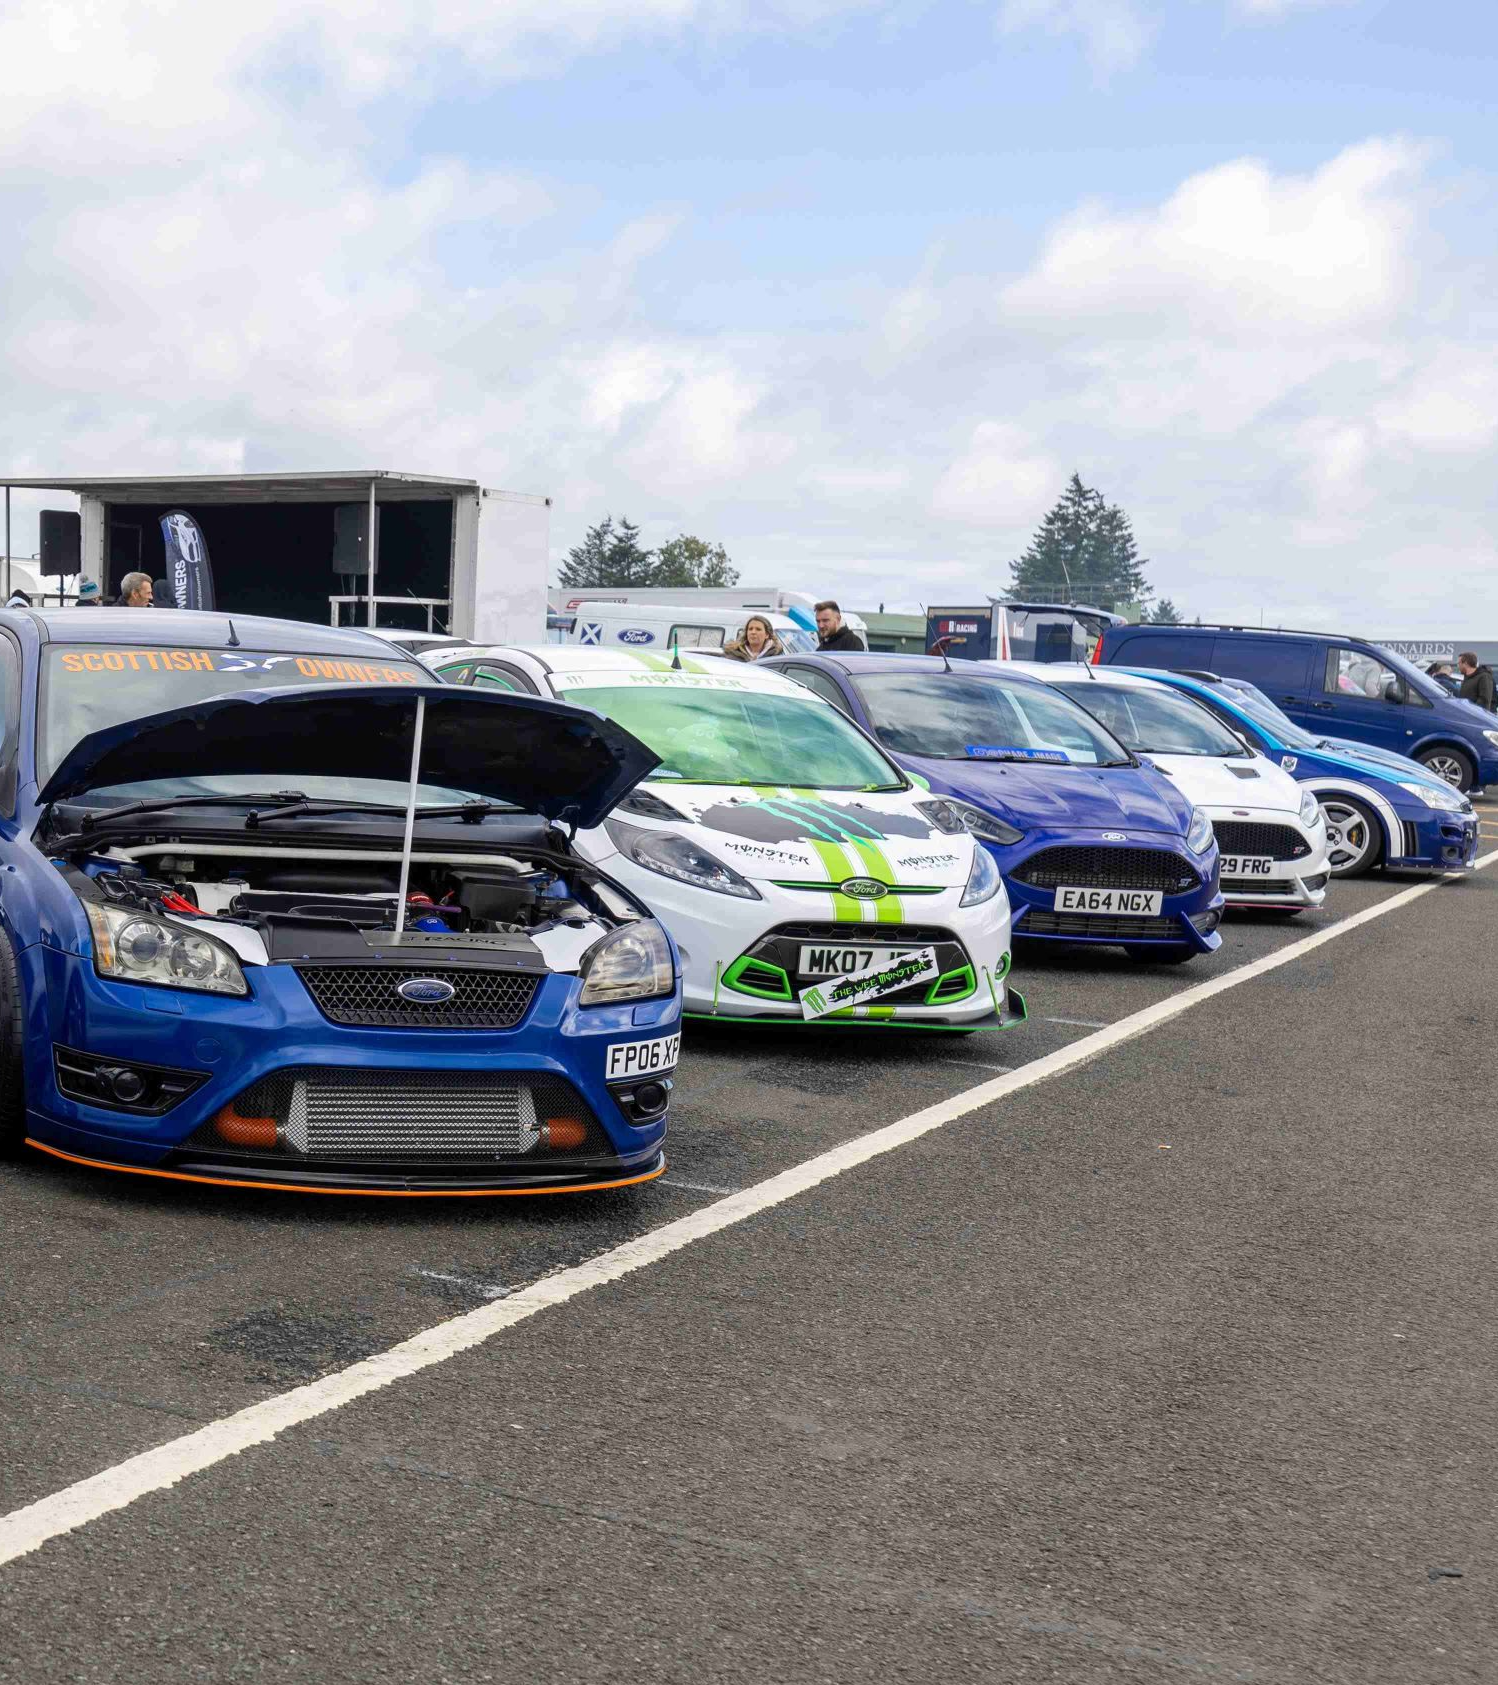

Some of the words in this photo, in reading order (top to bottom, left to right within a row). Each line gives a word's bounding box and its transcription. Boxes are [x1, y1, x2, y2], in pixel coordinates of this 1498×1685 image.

[174, 560, 187, 609] WNERS
[622, 630, 648, 642] Ford
[1381, 642, 1455, 655] NNAIRDS
[61, 651, 215, 672] SCOTTISH
[295, 657, 418, 684] OWNERS
[1241, 859, 1271, 874] FRG
[852, 881, 878, 894] Ford
[1062, 890, 1112, 910] EA64
[1117, 893, 1154, 912] NGX
[808, 949, 874, 974] MK07
[411, 983, 443, 997] Ford
[833, 986, 854, 1000] THE
[854, 978, 878, 992] WEE
[610, 1042, 661, 1075] FP06
